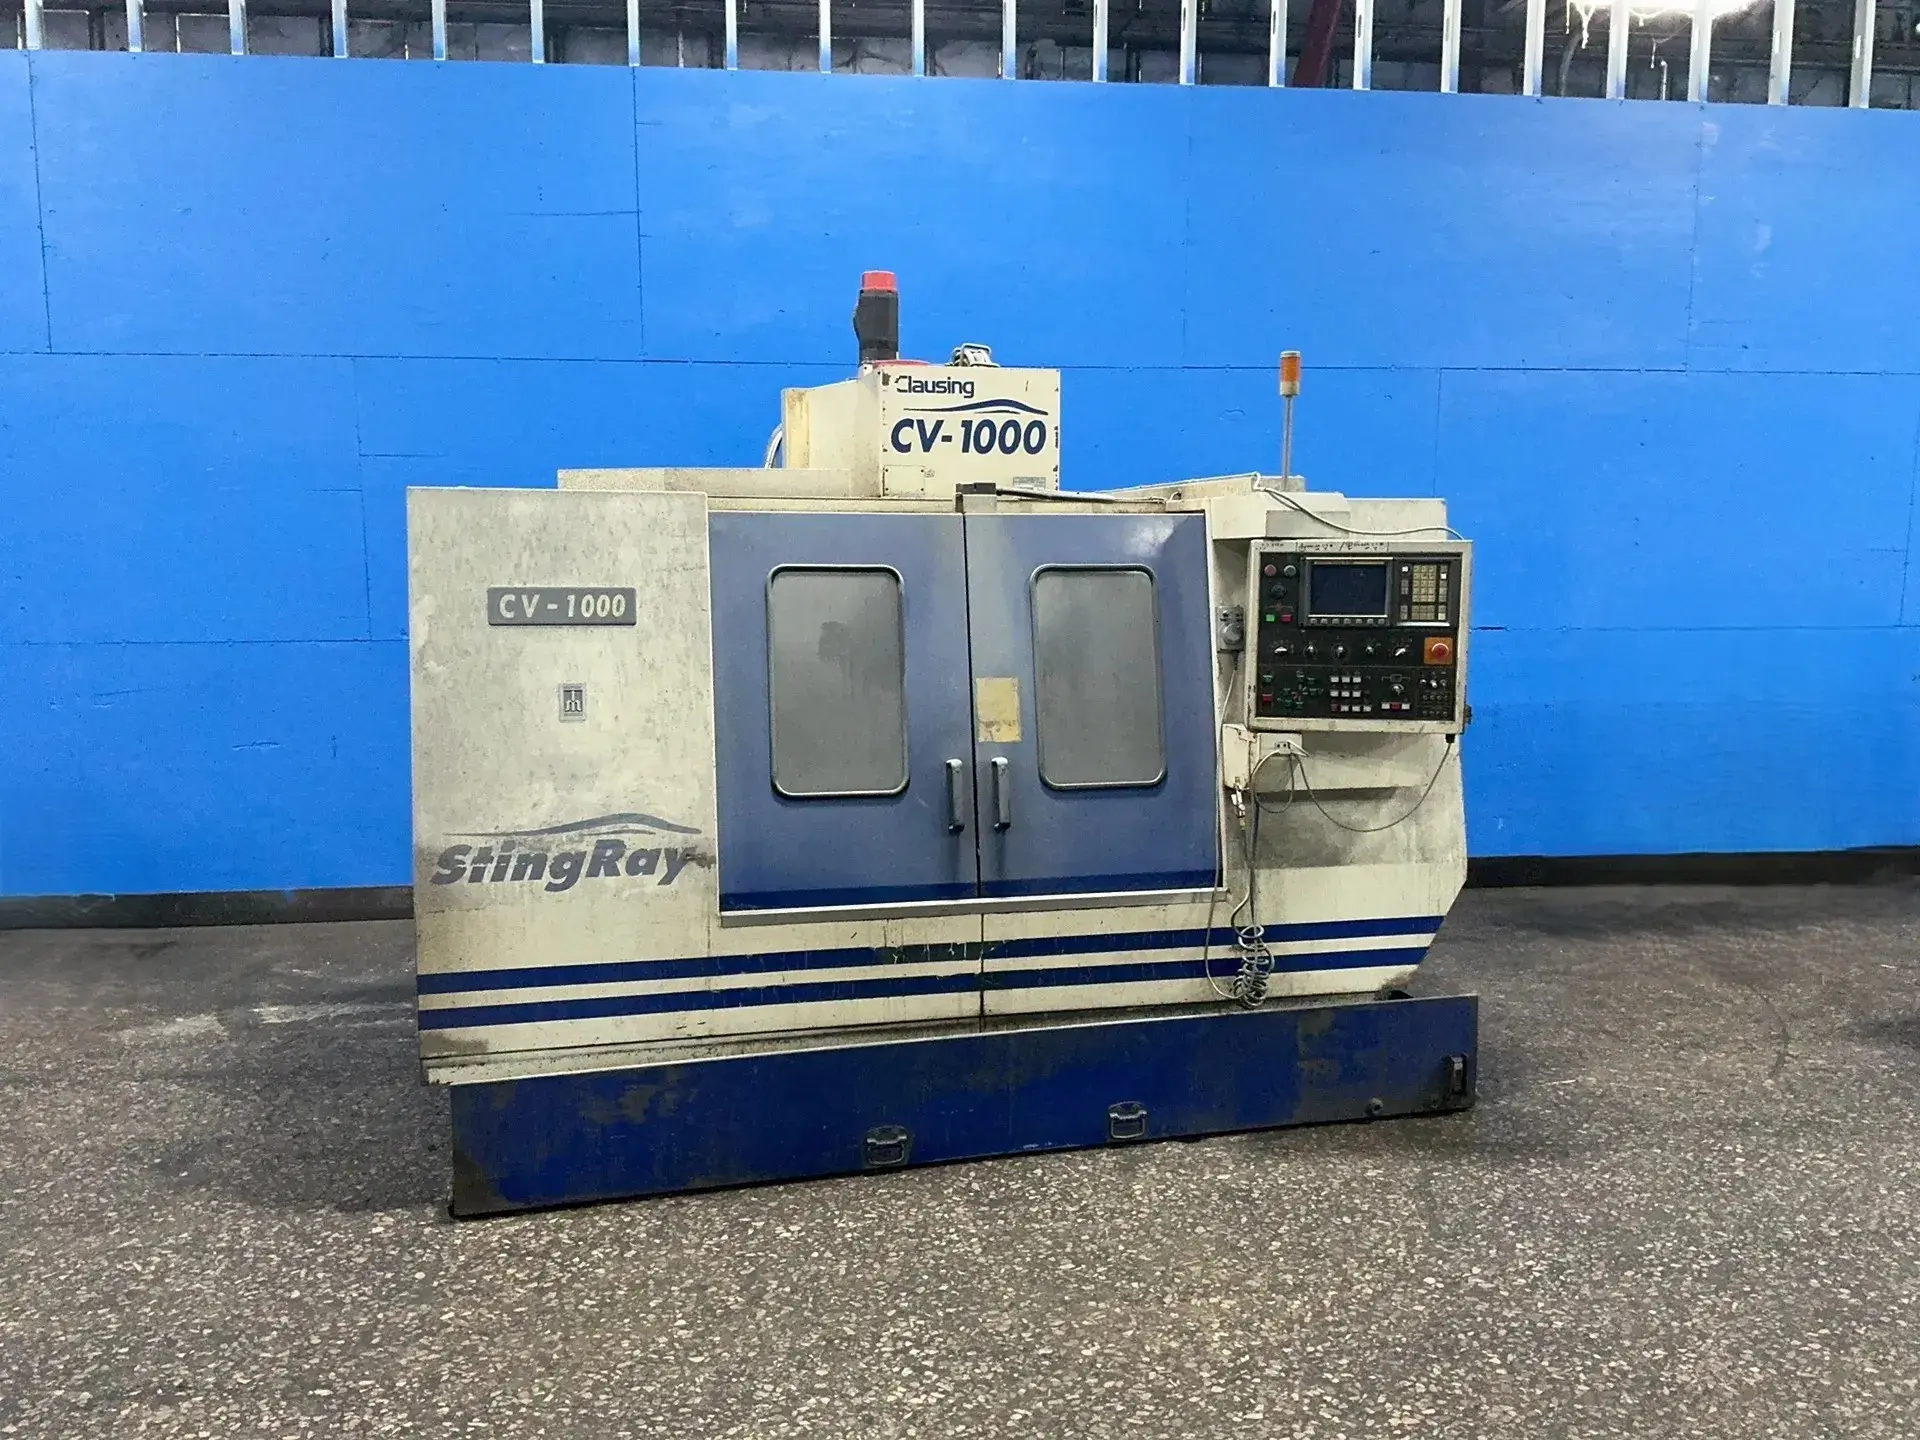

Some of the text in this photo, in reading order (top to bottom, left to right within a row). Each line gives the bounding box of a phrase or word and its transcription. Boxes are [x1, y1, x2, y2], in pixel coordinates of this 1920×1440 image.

[894, 376, 975, 399] Clausing
[890, 418, 1047, 455] CV-1000
[430, 839, 698, 893] StingRay
